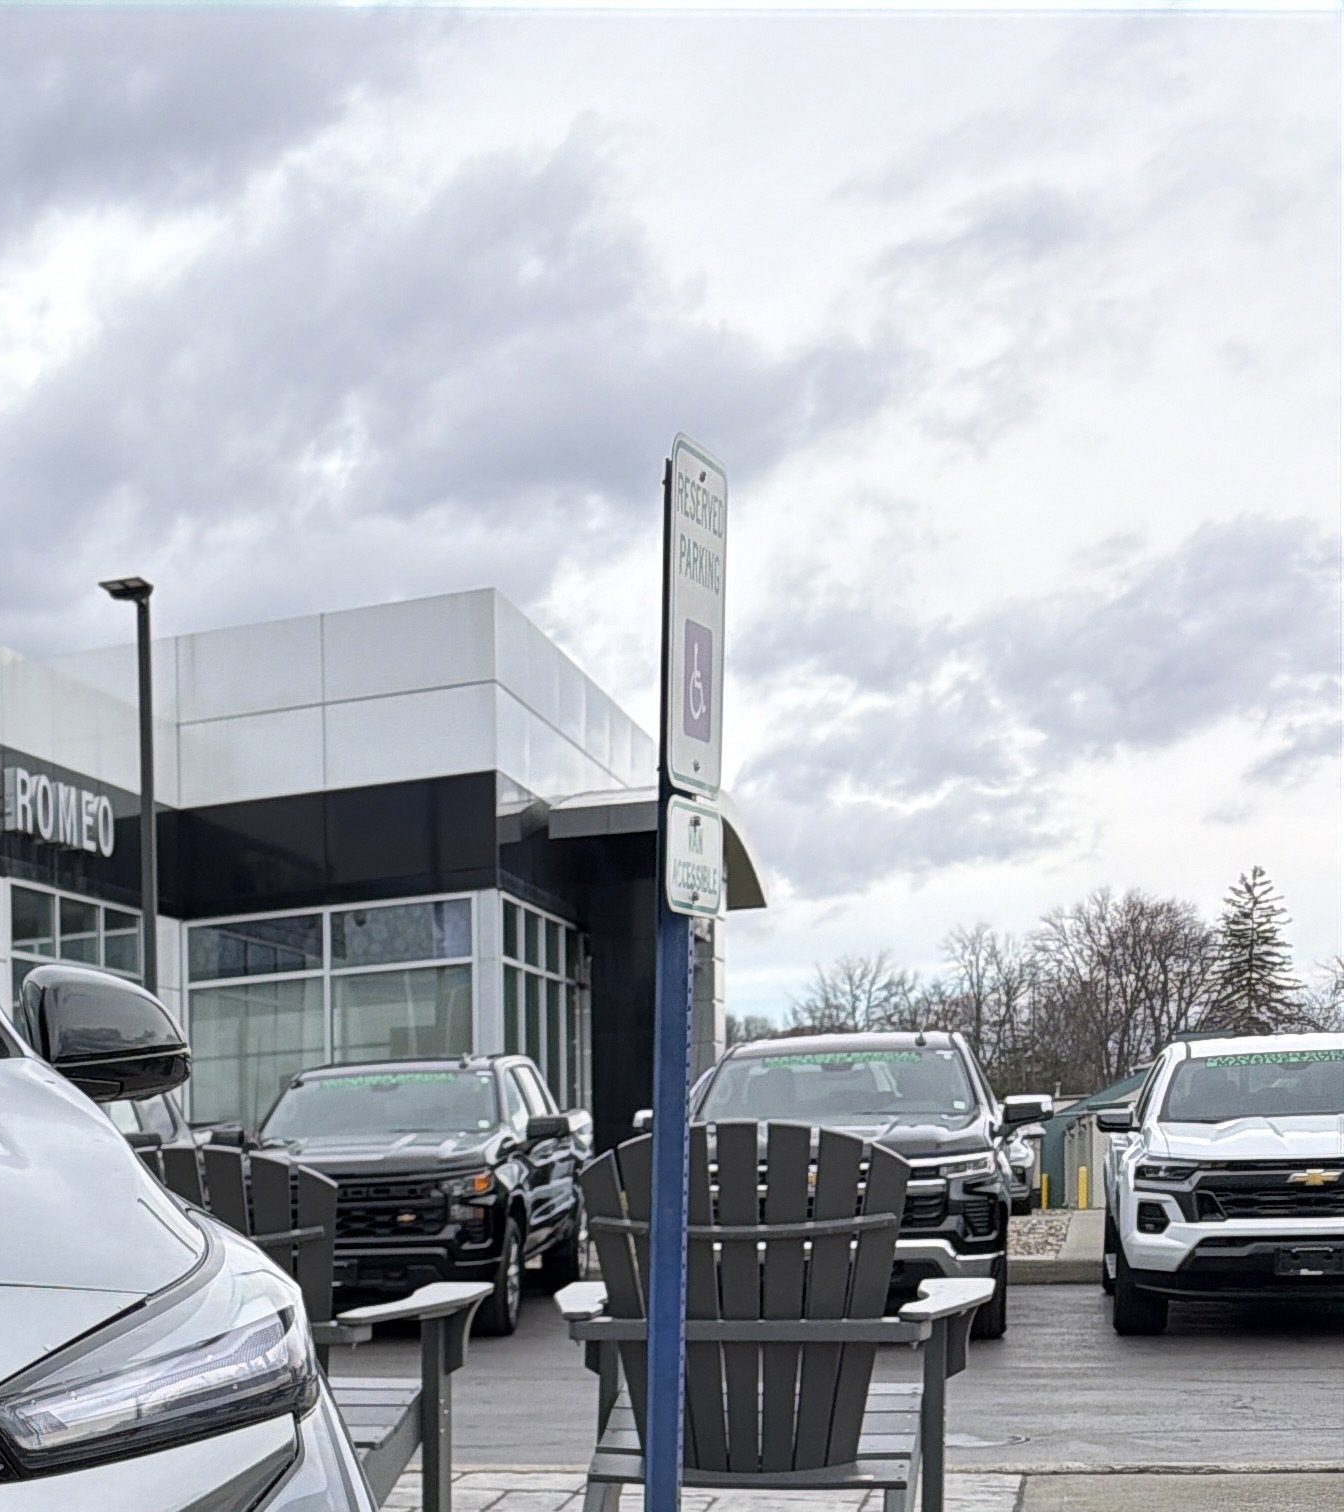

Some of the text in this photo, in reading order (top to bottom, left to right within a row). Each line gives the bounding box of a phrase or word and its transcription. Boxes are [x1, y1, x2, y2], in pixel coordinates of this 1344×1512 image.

[676, 471, 724, 538] RESERVED
[679, 533, 721, 595] PARKING
[12, 767, 114, 858] ROMEO
